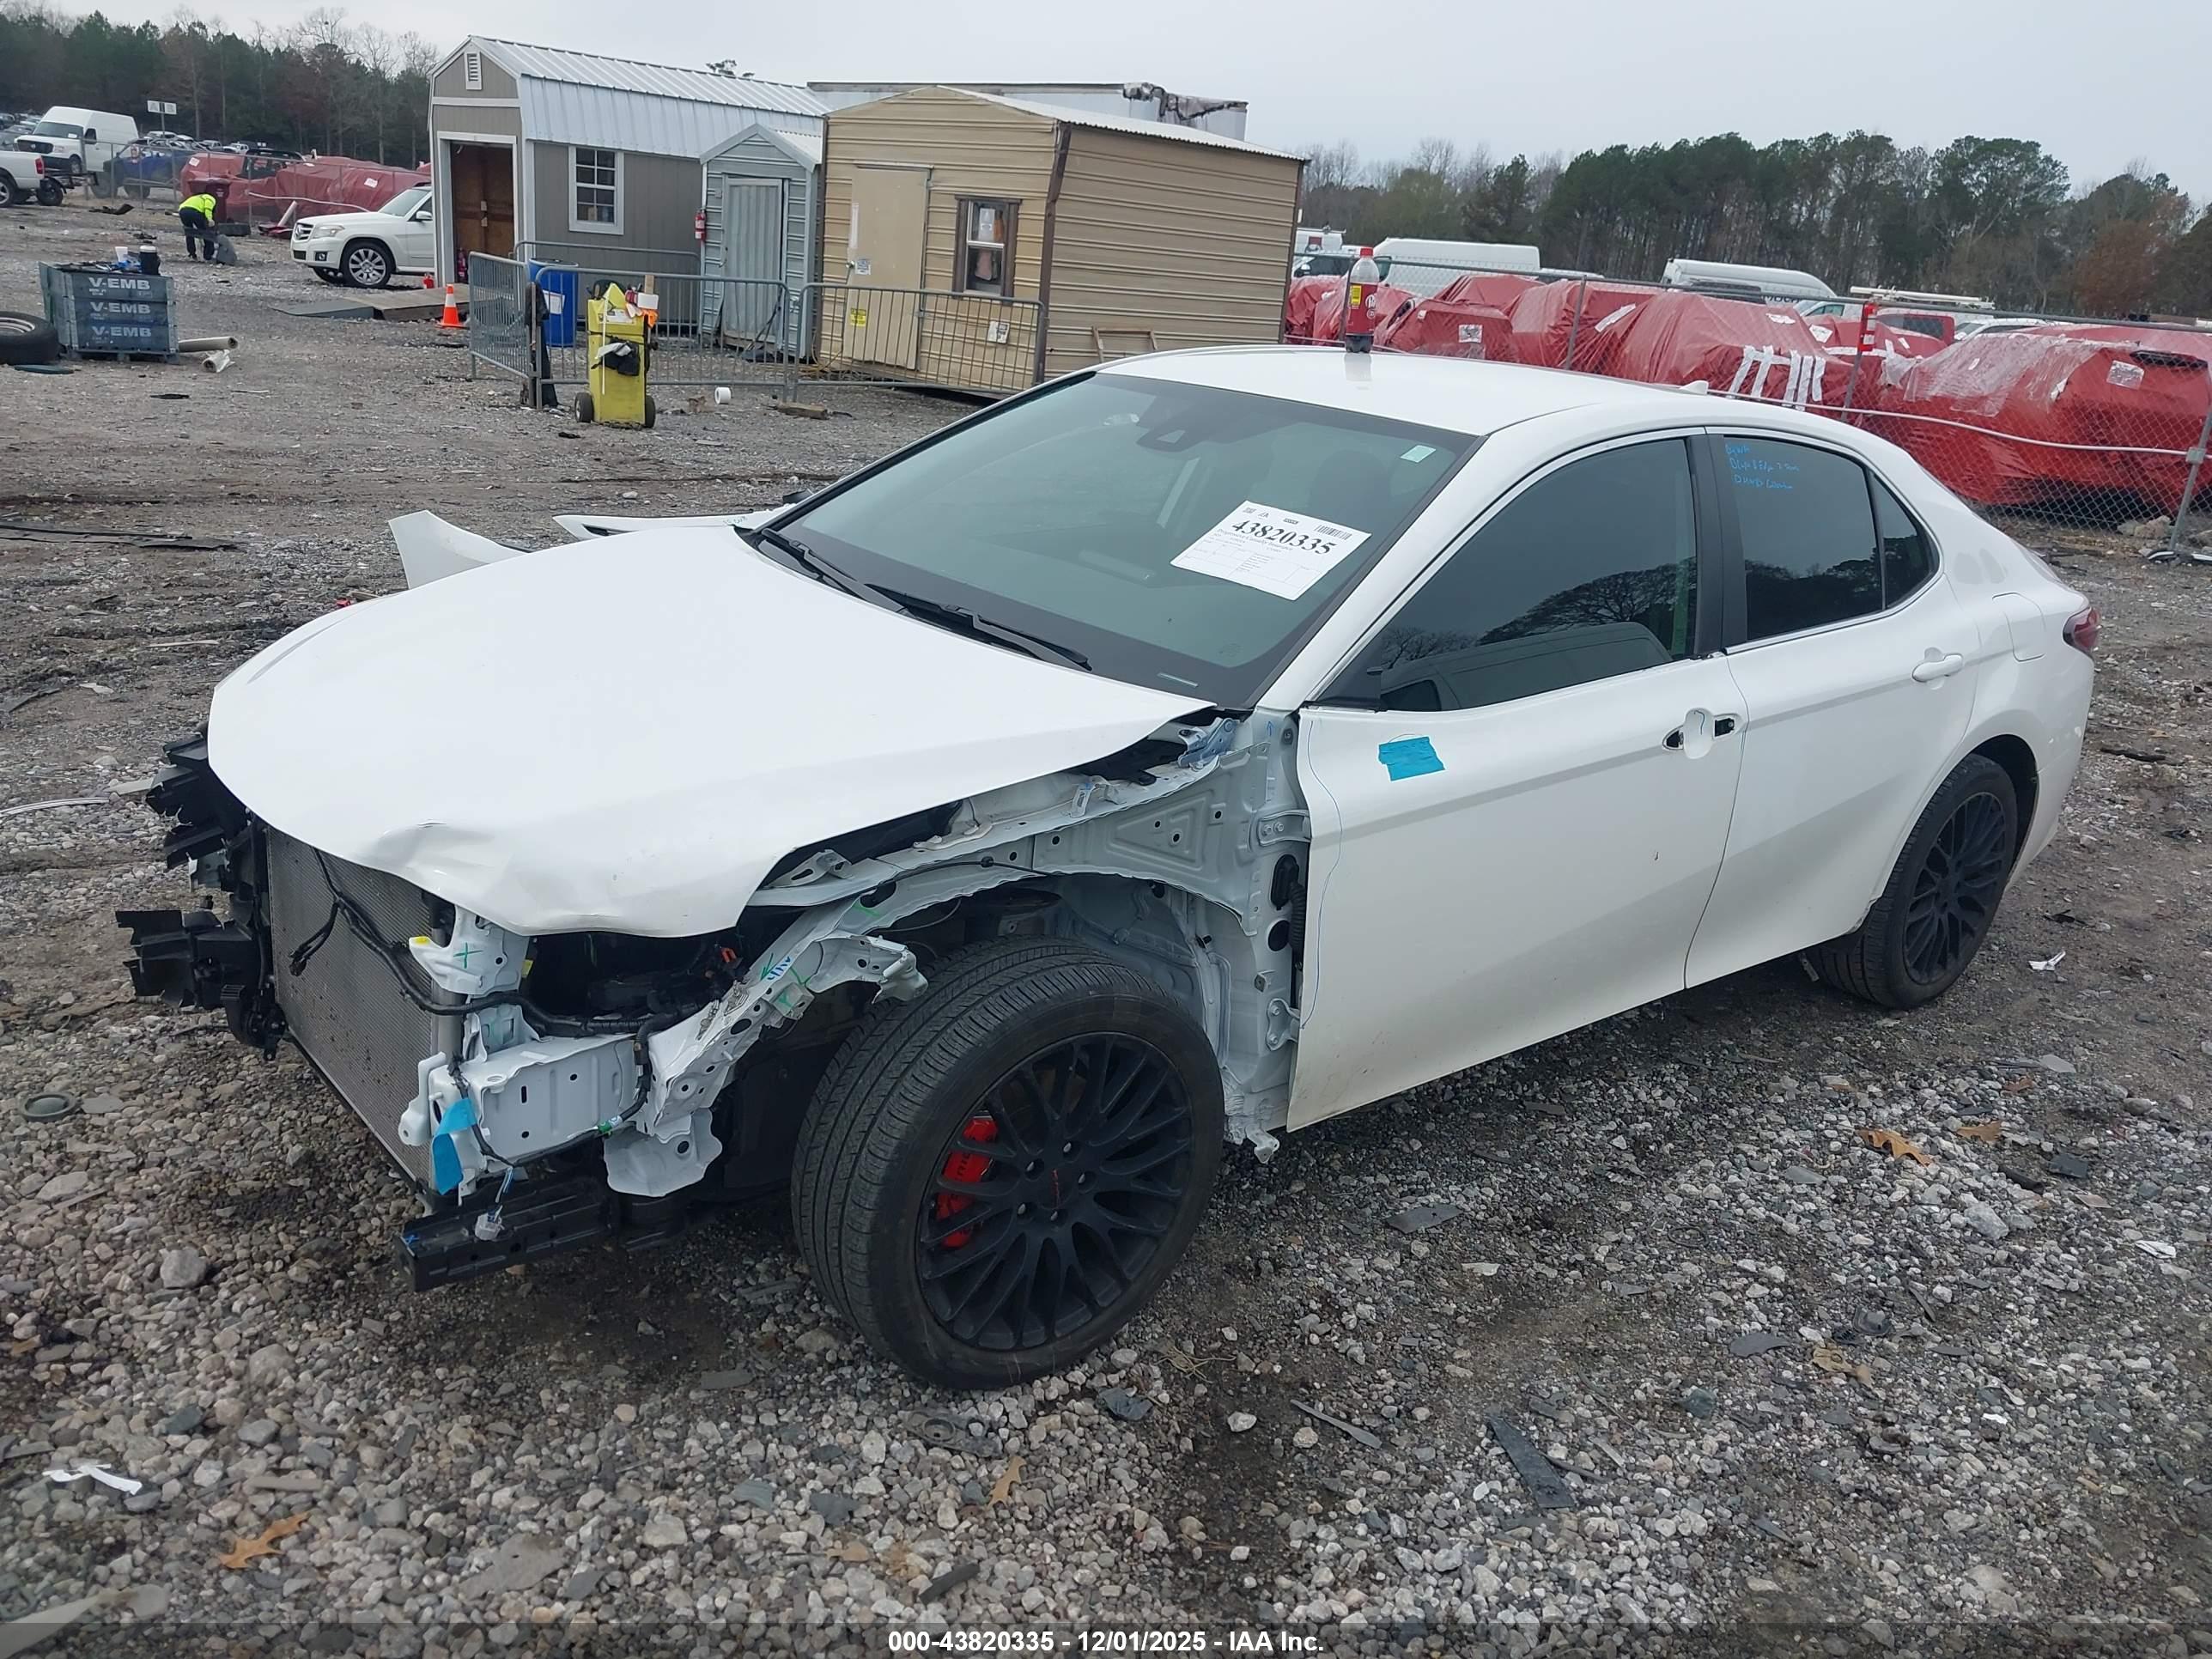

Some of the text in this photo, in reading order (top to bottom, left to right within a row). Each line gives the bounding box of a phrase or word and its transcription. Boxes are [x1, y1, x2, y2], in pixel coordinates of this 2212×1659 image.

[88, 276, 150, 289] V-EMB
[90, 301, 151, 313] V-EMB
[91, 326, 152, 337] V-EMB
[1231, 520, 1338, 555] 43820335
